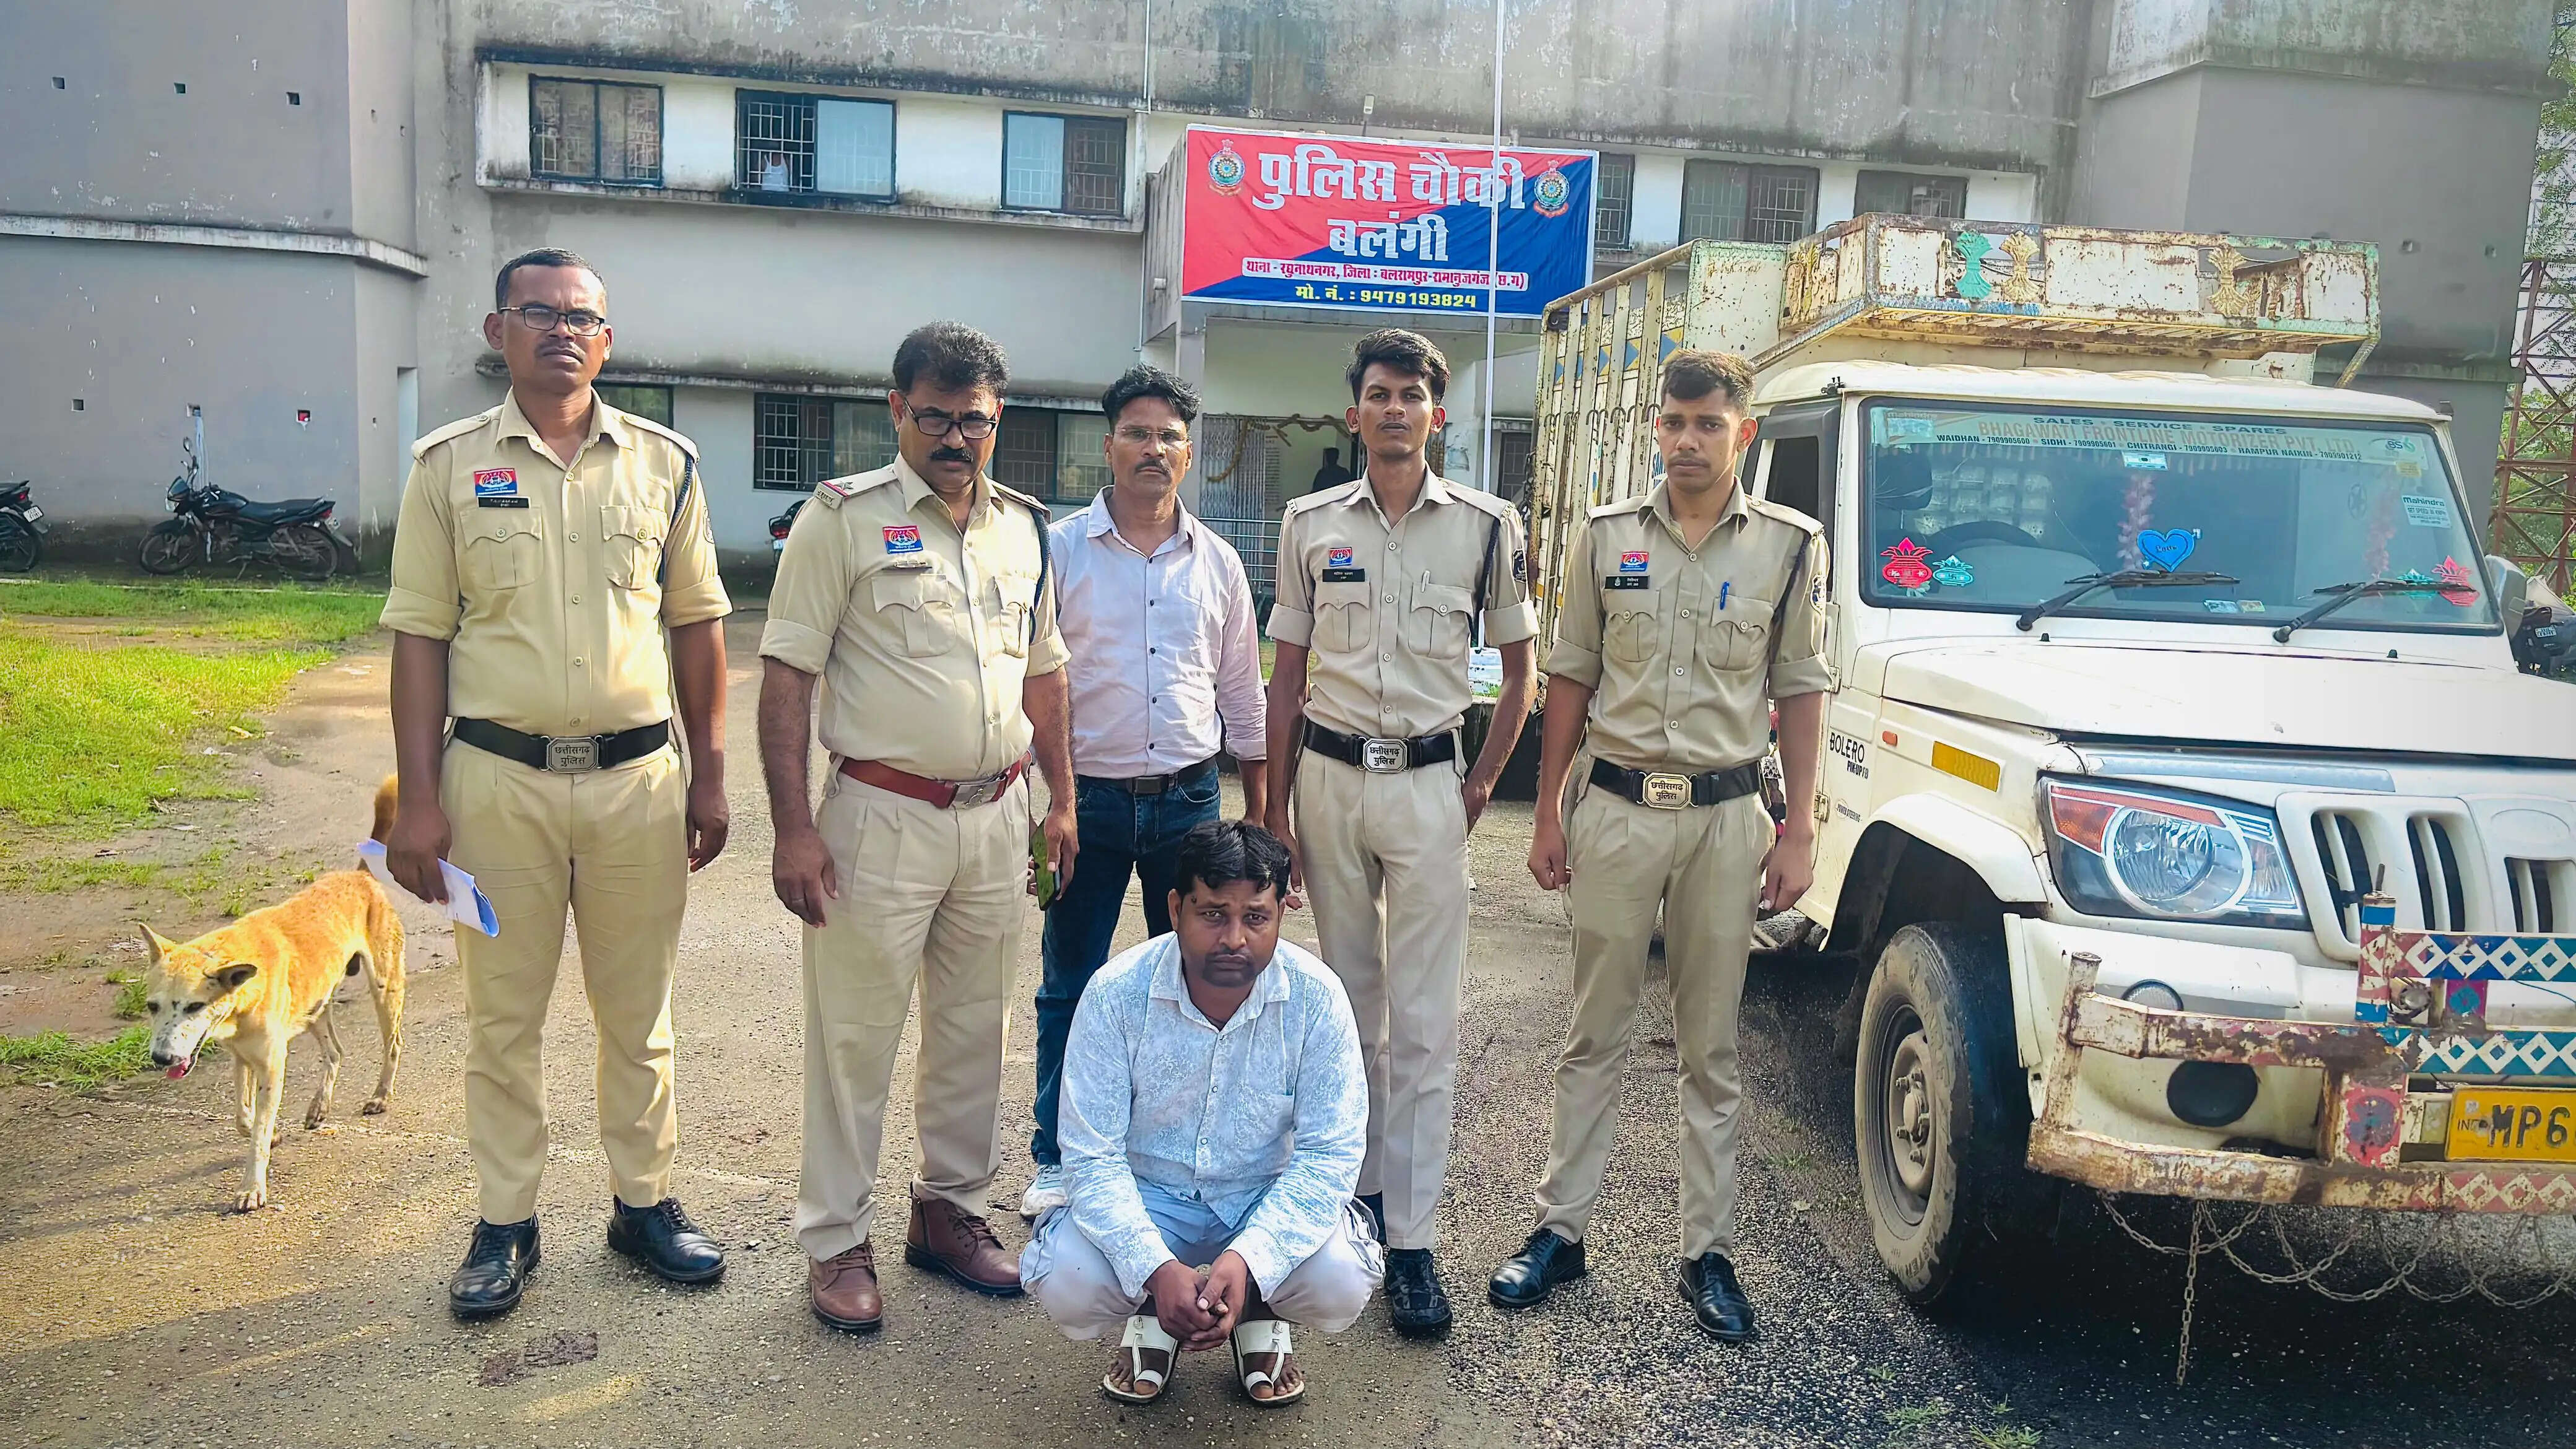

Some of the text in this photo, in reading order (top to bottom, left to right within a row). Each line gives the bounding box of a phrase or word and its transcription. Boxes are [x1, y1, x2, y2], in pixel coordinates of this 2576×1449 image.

[1252, 145, 1526, 210] पुलिस चौकी
[1328, 211, 1449, 261] बलंगी
[1246, 261, 1270, 272] थाना
[1343, 264, 1370, 278] जिला
[1295, 283, 1320, 300] मो.
[1360, 290, 1476, 308] 9479193824
[1978, 421, 2076, 439] BHAGAWATI
[2082, 425, 2176, 443] FRONTLINE
[2182, 430, 2280, 448] MOTORIZER
[2033, 417, 2288, 434] SALES SERVICE SPARES
[1987, 437, 2030, 445] 7909905600
[2127, 442, 2177, 451] CHITRANGI
[1829, 732, 1865, 764] BOLERO
[561, 755, 586, 767] पुलिस
[1373, 756, 1396, 766] पुलिस
[1656, 791, 1677, 801] पुलिस
[2487, 1105, 2576, 1148] MP6
